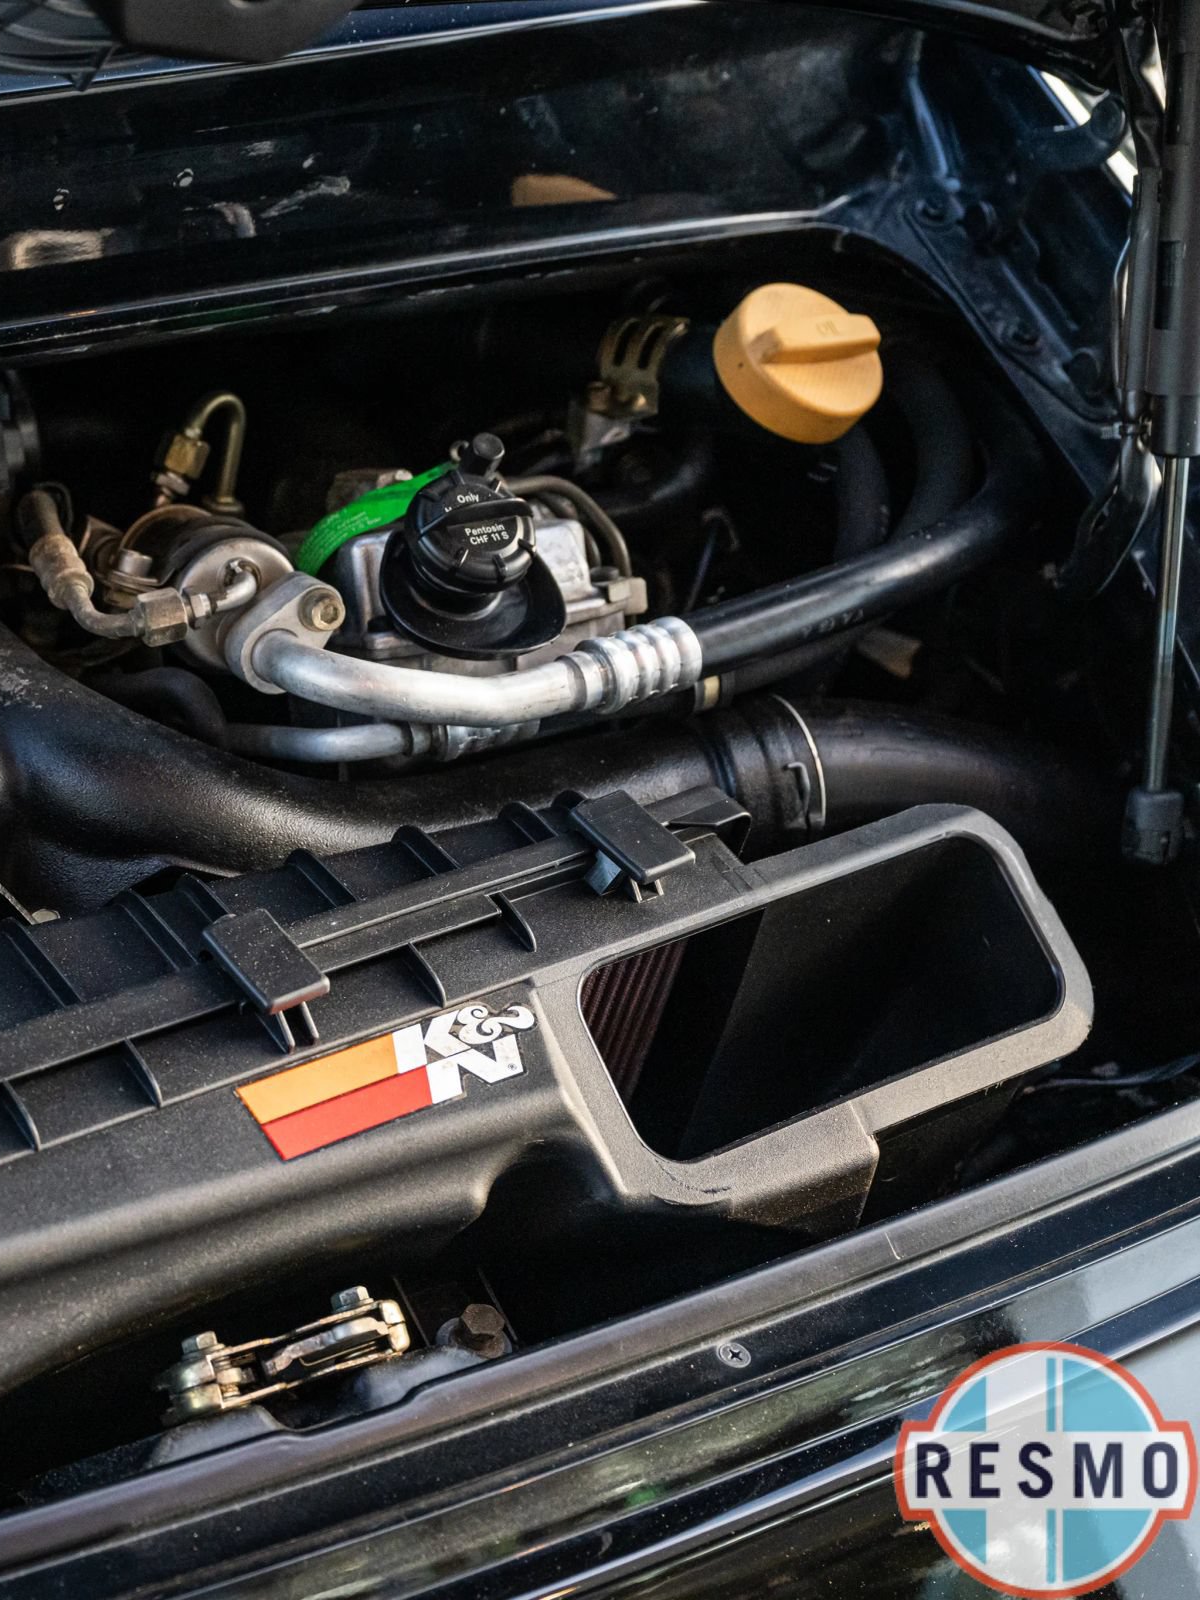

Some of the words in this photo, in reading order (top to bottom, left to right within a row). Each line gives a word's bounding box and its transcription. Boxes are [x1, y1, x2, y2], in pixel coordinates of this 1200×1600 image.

[456, 491, 480, 504] Only
[464, 523, 506, 537] Pentosin
[469, 534, 489, 546] CHF
[391, 1004, 536, 1105] K&N
